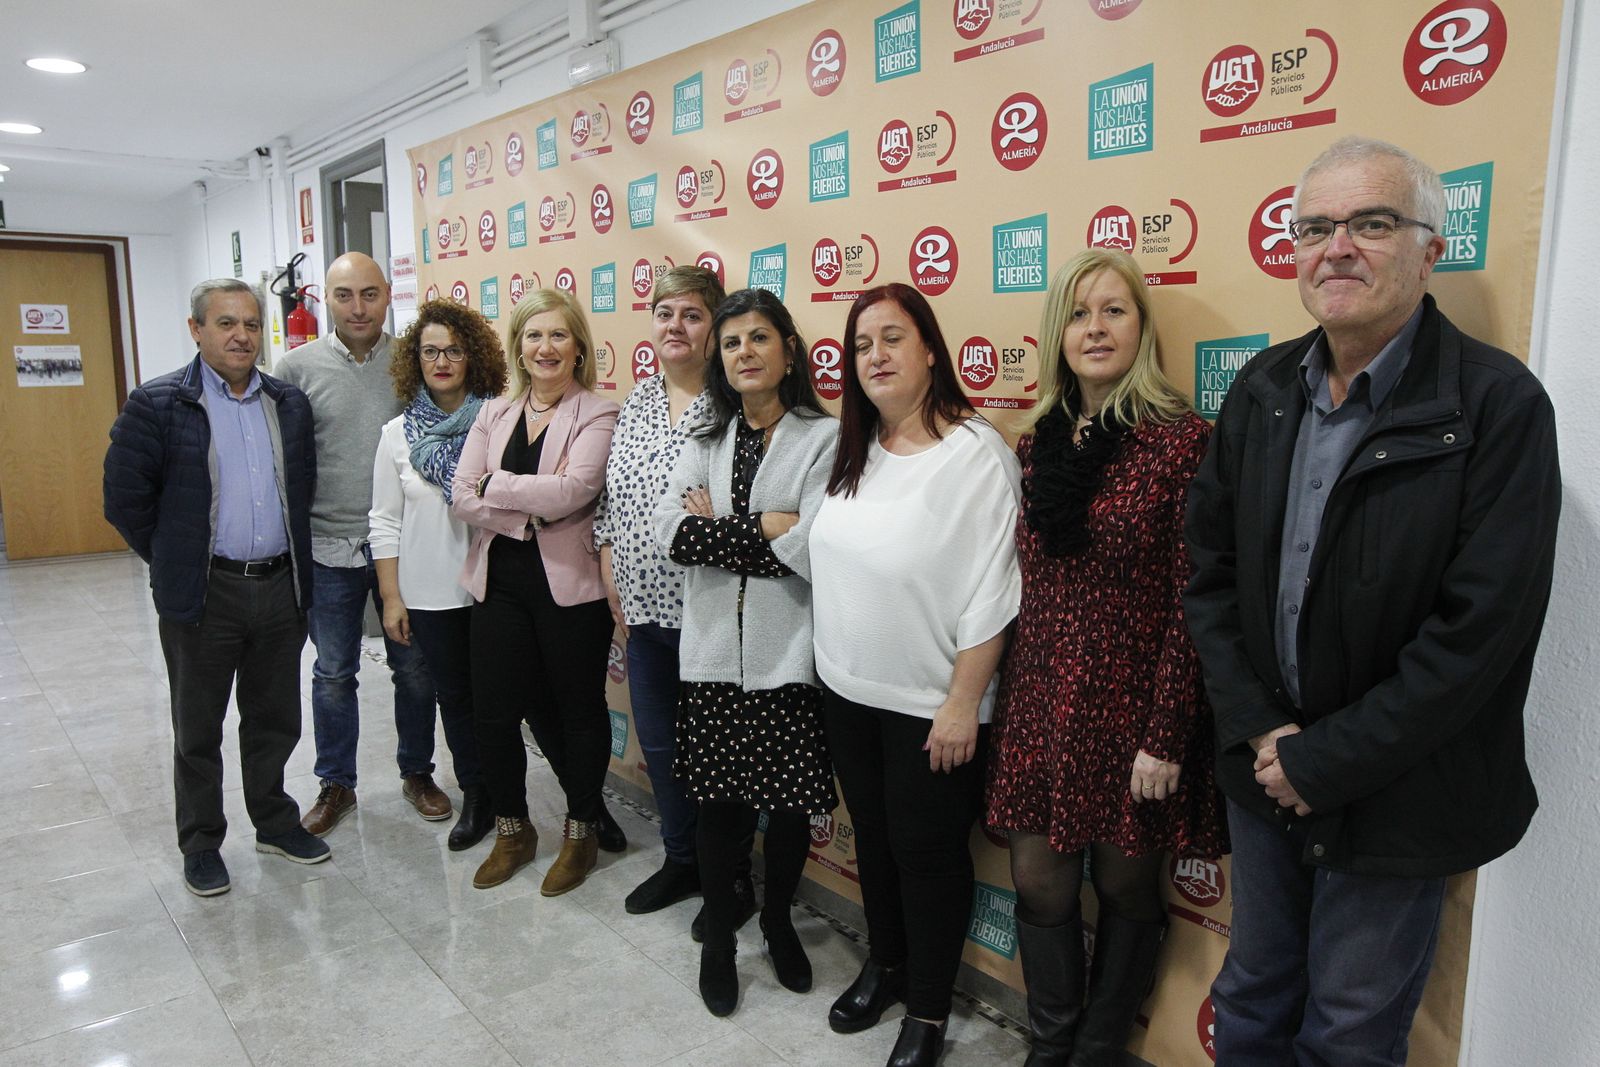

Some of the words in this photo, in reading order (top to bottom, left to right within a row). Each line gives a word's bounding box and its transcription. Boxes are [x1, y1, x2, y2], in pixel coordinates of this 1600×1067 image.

[878, 23, 889, 41] LA
[890, 13, 916, 37] UNIÓN
[879, 39, 895, 56] NOS
[895, 31, 916, 53] HACE
[980, 38, 1016, 54] Andalucía
[880, 49, 917, 74] FUERTES
[1209, 54, 1256, 88] UGT
[727, 65, 747, 87] UGT
[812, 74, 839, 88] ALMERÍA
[1271, 72, 1305, 85] Servicios
[1420, 69, 1484, 93] ALMERÍA
[1094, 91, 1110, 111] LA
[1112, 80, 1147, 107] UNIÓN
[1271, 84, 1302, 96] Públicos
[1094, 108, 1116, 130] NOS
[1117, 102, 1147, 126] HACE
[1094, 123, 1147, 150] FUERTES
[1240, 118, 1293, 136] Andalucía
[881, 127, 908, 151] UGT
[917, 142, 938, 151] Servicios
[813, 149, 822, 165] LA
[823, 143, 845, 162] UNIÓN
[1001, 146, 1038, 161] ALMERÍA
[813, 163, 827, 180] NOS
[827, 160, 845, 177] HACE
[679, 172, 696, 191] UGT
[813, 176, 846, 195] FUERTES
[900, 176, 932, 188] Andalucía
[753, 190, 778, 201] ALMERÍA
[1444, 181, 1482, 212] NIÓN
[1092, 215, 1130, 242] UGT
[998, 232, 1011, 251] LA
[1012, 226, 1042, 249] UNIÓN
[1142, 235, 1171, 245] Servicios
[815, 246, 838, 265] UGT
[998, 249, 1016, 267] NOS
[1017, 247, 1042, 266] HACE
[1142, 245, 1169, 254] Públicos
[753, 257, 762, 271] LA
[763, 253, 784, 270] UNIÓN
[1262, 253, 1296, 266] ALME
[635, 265, 650, 282] UGT
[751, 271, 765, 284] NOS
[765, 270, 782, 283] HACE
[918, 274, 950, 286] ALMERÍA
[998, 265, 1042, 285] FUERTES
[832, 291, 859, 301] Andalucía
[962, 345, 992, 367] UGT
[1202, 351, 1218, 371] LA
[1220, 347, 1260, 371] UNIÓ
[1002, 366, 1025, 374] Servicios
[1002, 374, 1024, 382] Públicos
[817, 382, 842, 391] ALMERÍA
[1202, 371, 1225, 390] NOS
[983, 398, 1019, 408] Andalucía
[1176, 857, 1218, 886] UGT
[976, 886, 989, 906] LA
[976, 903, 991, 924] NOS
[992, 909, 1016, 935] HACE
[971, 918, 1014, 951] FUERTES
